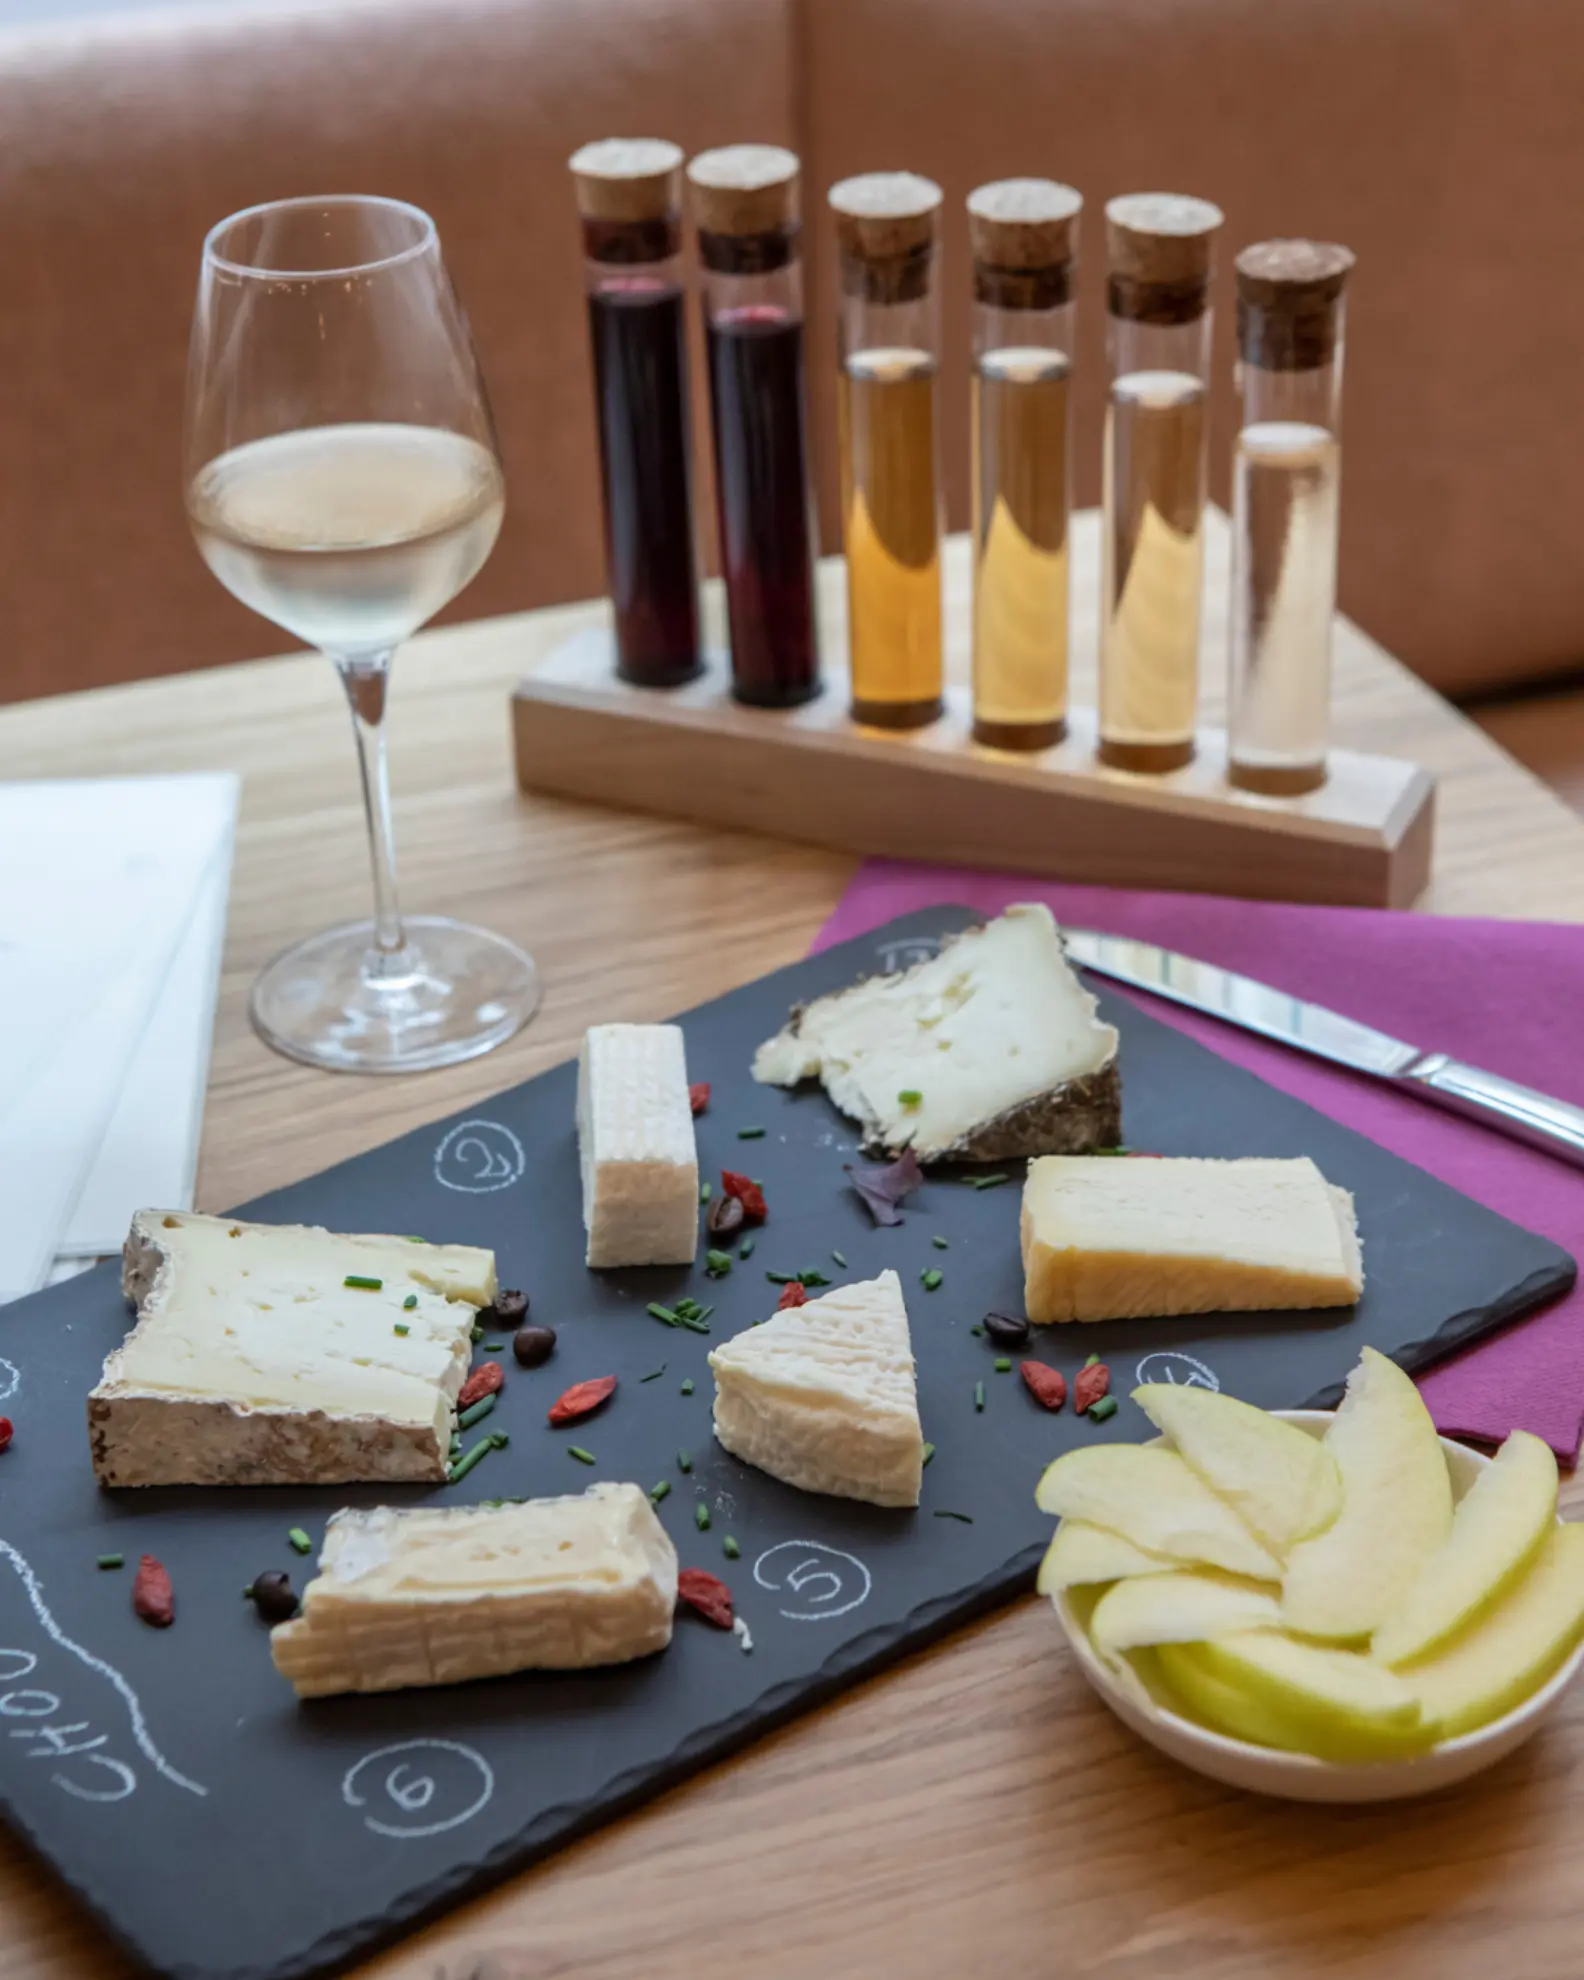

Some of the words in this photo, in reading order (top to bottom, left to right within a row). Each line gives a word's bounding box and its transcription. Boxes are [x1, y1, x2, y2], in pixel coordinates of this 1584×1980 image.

[455, 1137, 512, 1179] 2
[786, 1558, 842, 1603] 5
[386, 1763, 435, 1811] 6
